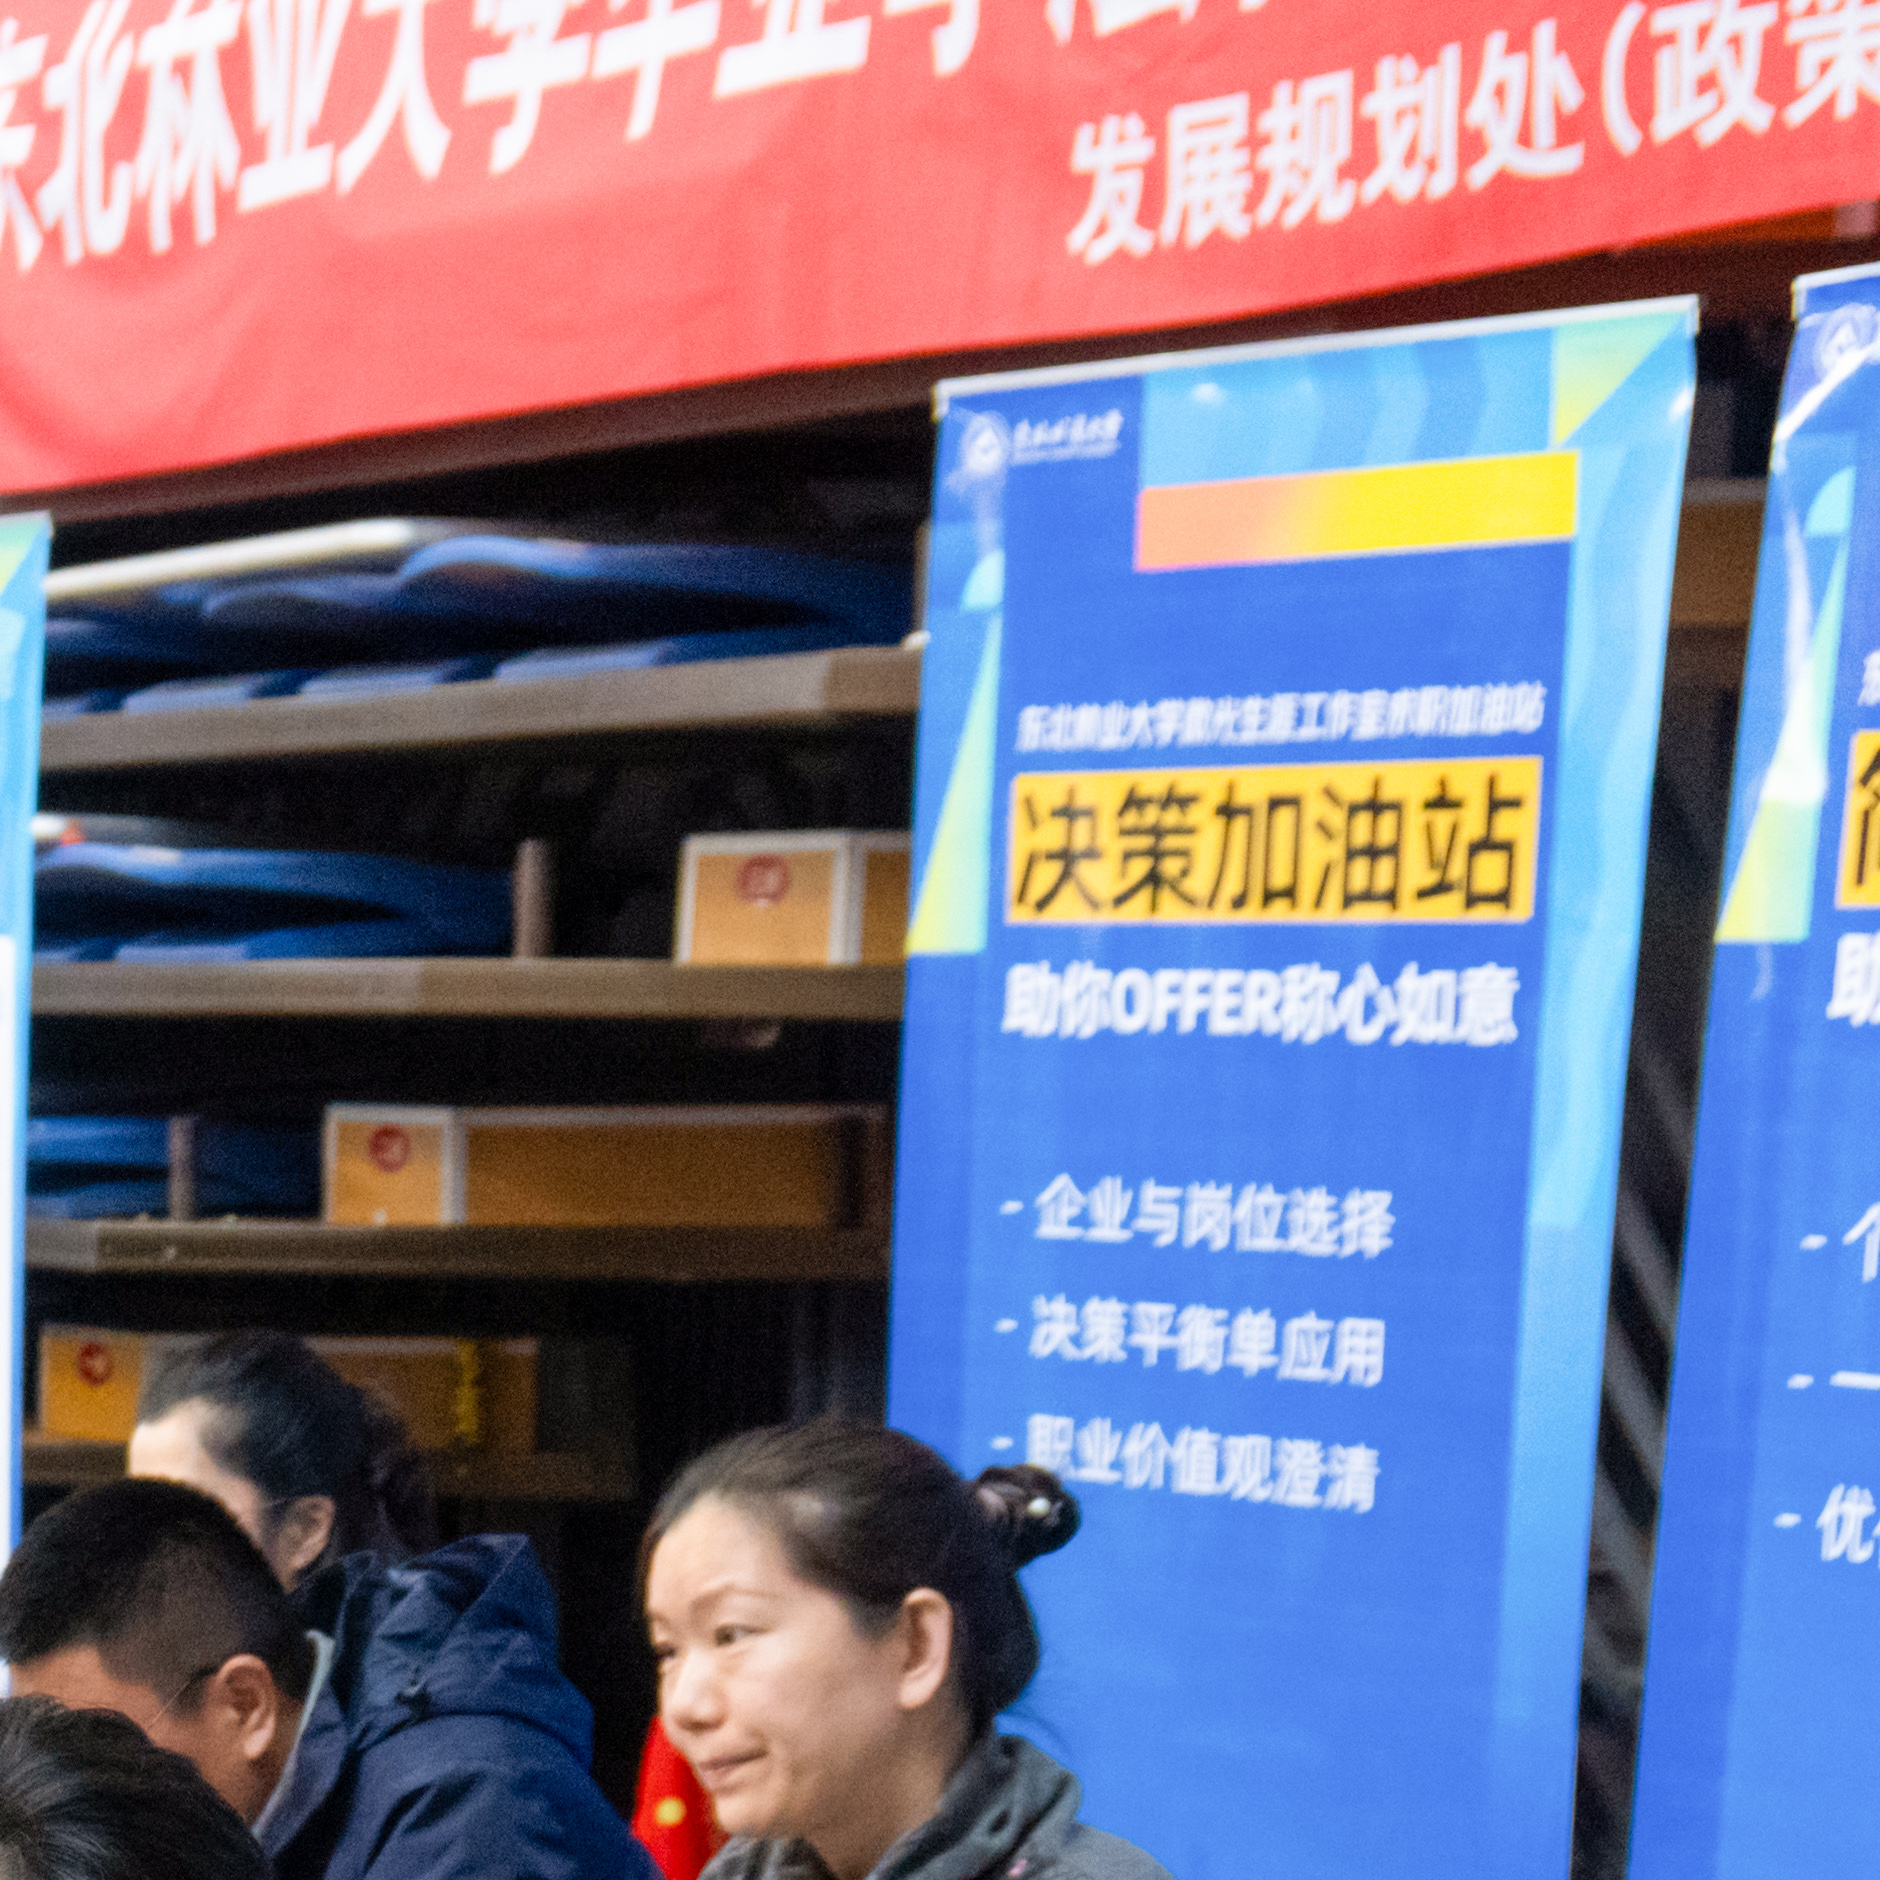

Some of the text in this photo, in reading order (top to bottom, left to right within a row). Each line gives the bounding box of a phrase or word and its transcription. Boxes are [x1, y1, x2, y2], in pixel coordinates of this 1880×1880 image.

[1015, 774, 1525, 914] 决策加油站
[1001, 962, 1518, 1046] 助你OFFER称心如意
[1035, 1172, 1395, 1259] 企业与岗位选择
[1029, 1296, 1386, 1387] 决策平衡单应用
[1025, 1413, 1380, 1513] 职业价值观澄清
